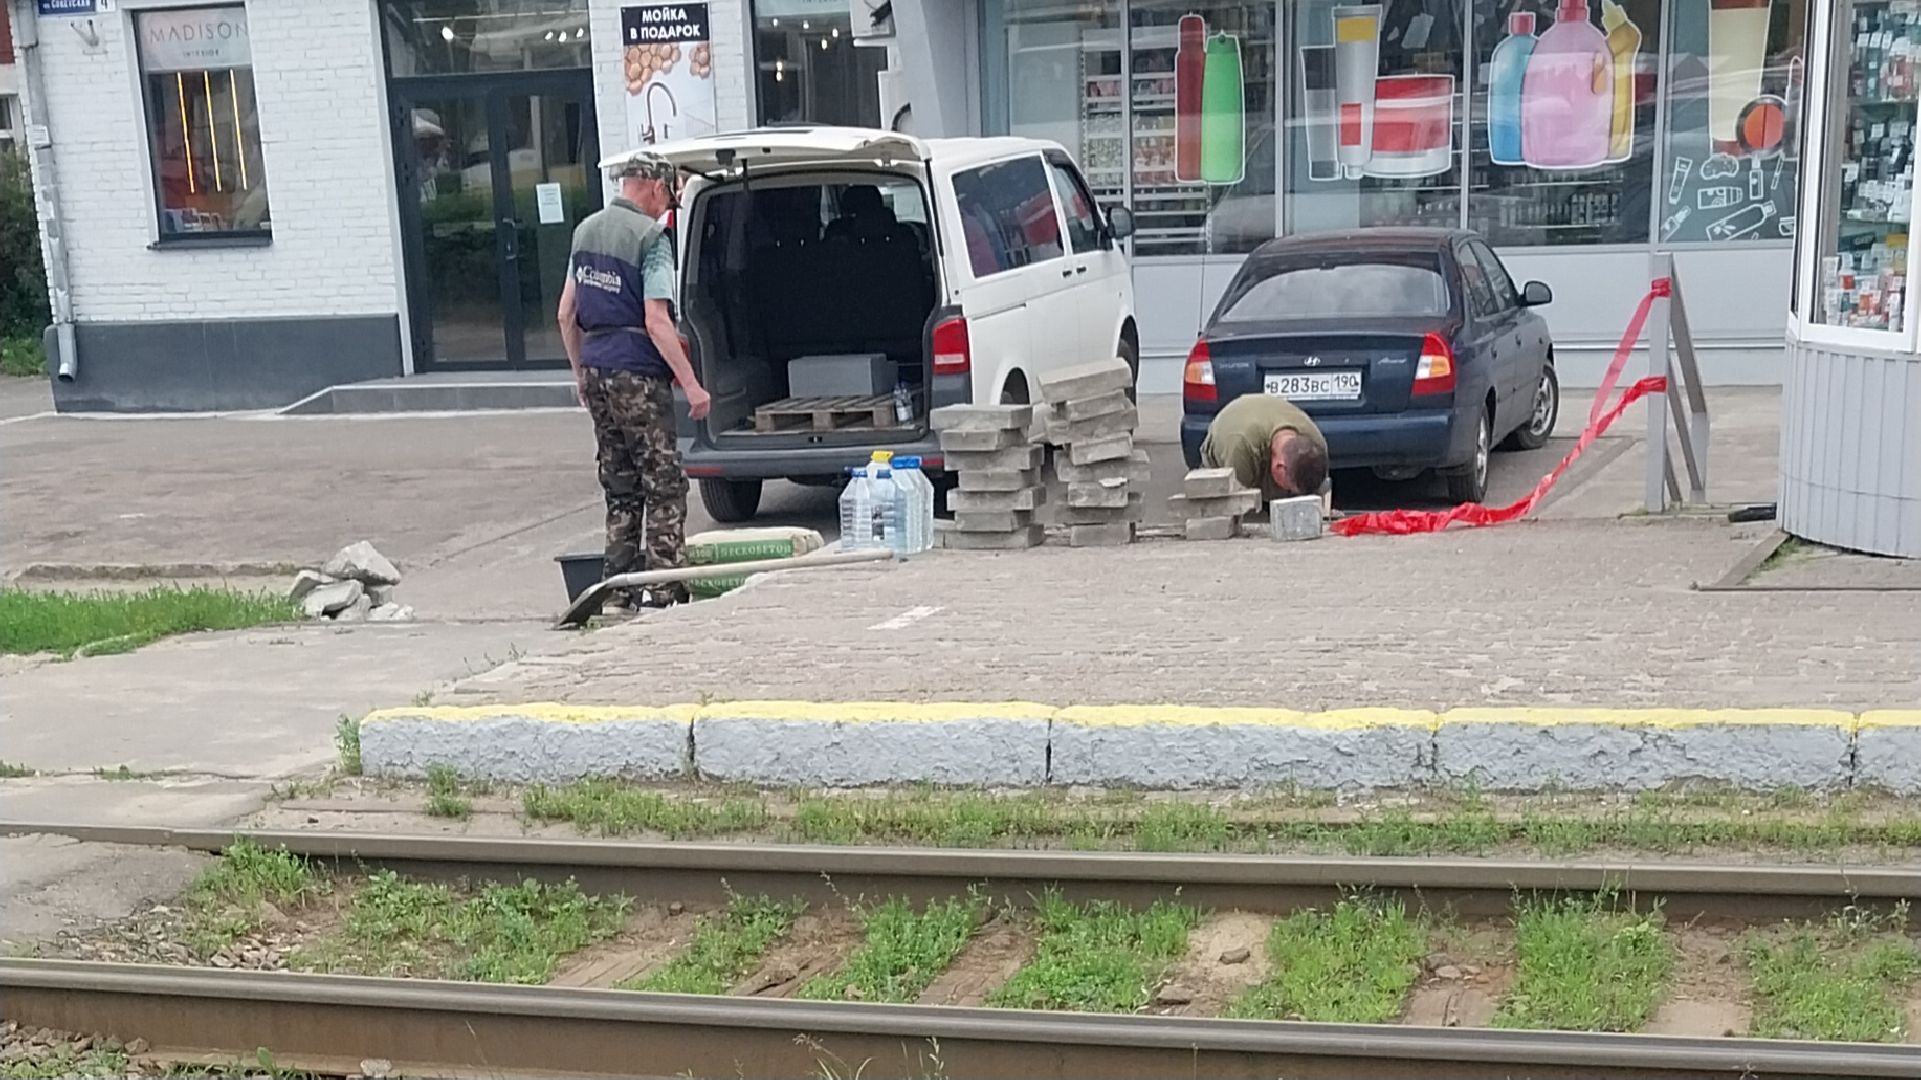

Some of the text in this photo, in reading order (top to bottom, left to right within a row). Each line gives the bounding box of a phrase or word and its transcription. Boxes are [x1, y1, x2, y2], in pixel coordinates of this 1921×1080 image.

[642, 7, 687, 23] МОЙКА
[150, 22, 248, 43] MADISON
[630, 24, 700, 40] В ПОДАРОК
[1334, 375, 1357, 388] 190
